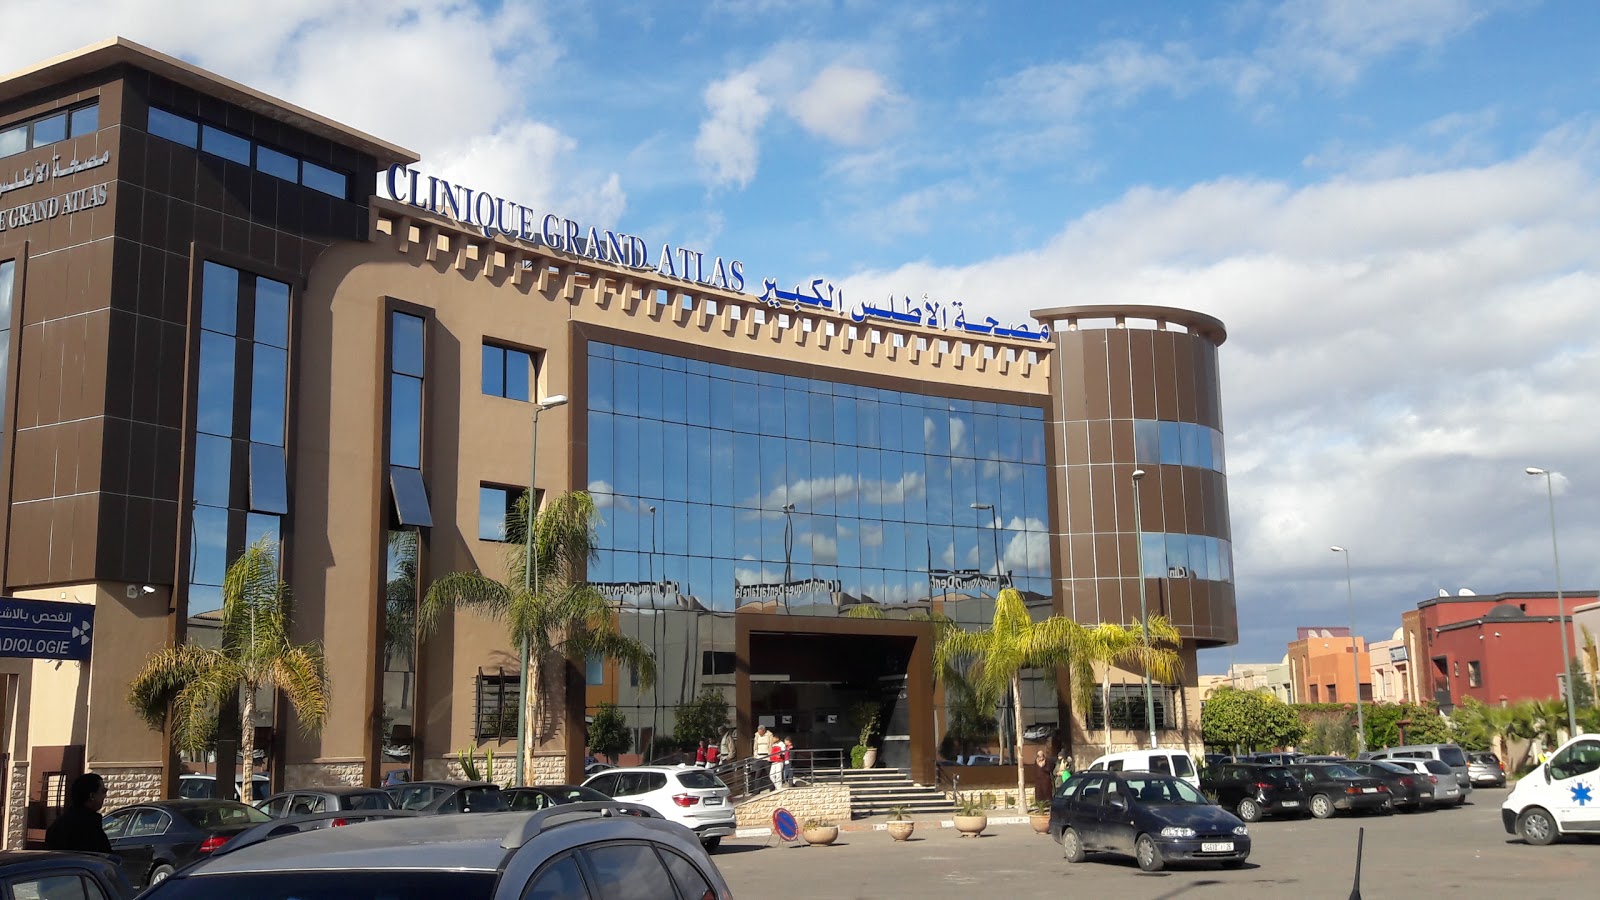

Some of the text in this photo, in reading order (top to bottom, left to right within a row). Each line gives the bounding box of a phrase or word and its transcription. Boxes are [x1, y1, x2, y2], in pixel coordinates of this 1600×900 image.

[52, 150, 110, 178] مصحة
[8, 197, 60, 229] GRAND
[61, 183, 108, 215] ATLAS
[385, 161, 745, 292] CLINIQUE GRAND ATLAS
[757, 277, 1050, 343] مصحة الأطلس الكبير
[0, 607, 72, 624] الفحص بالاش
